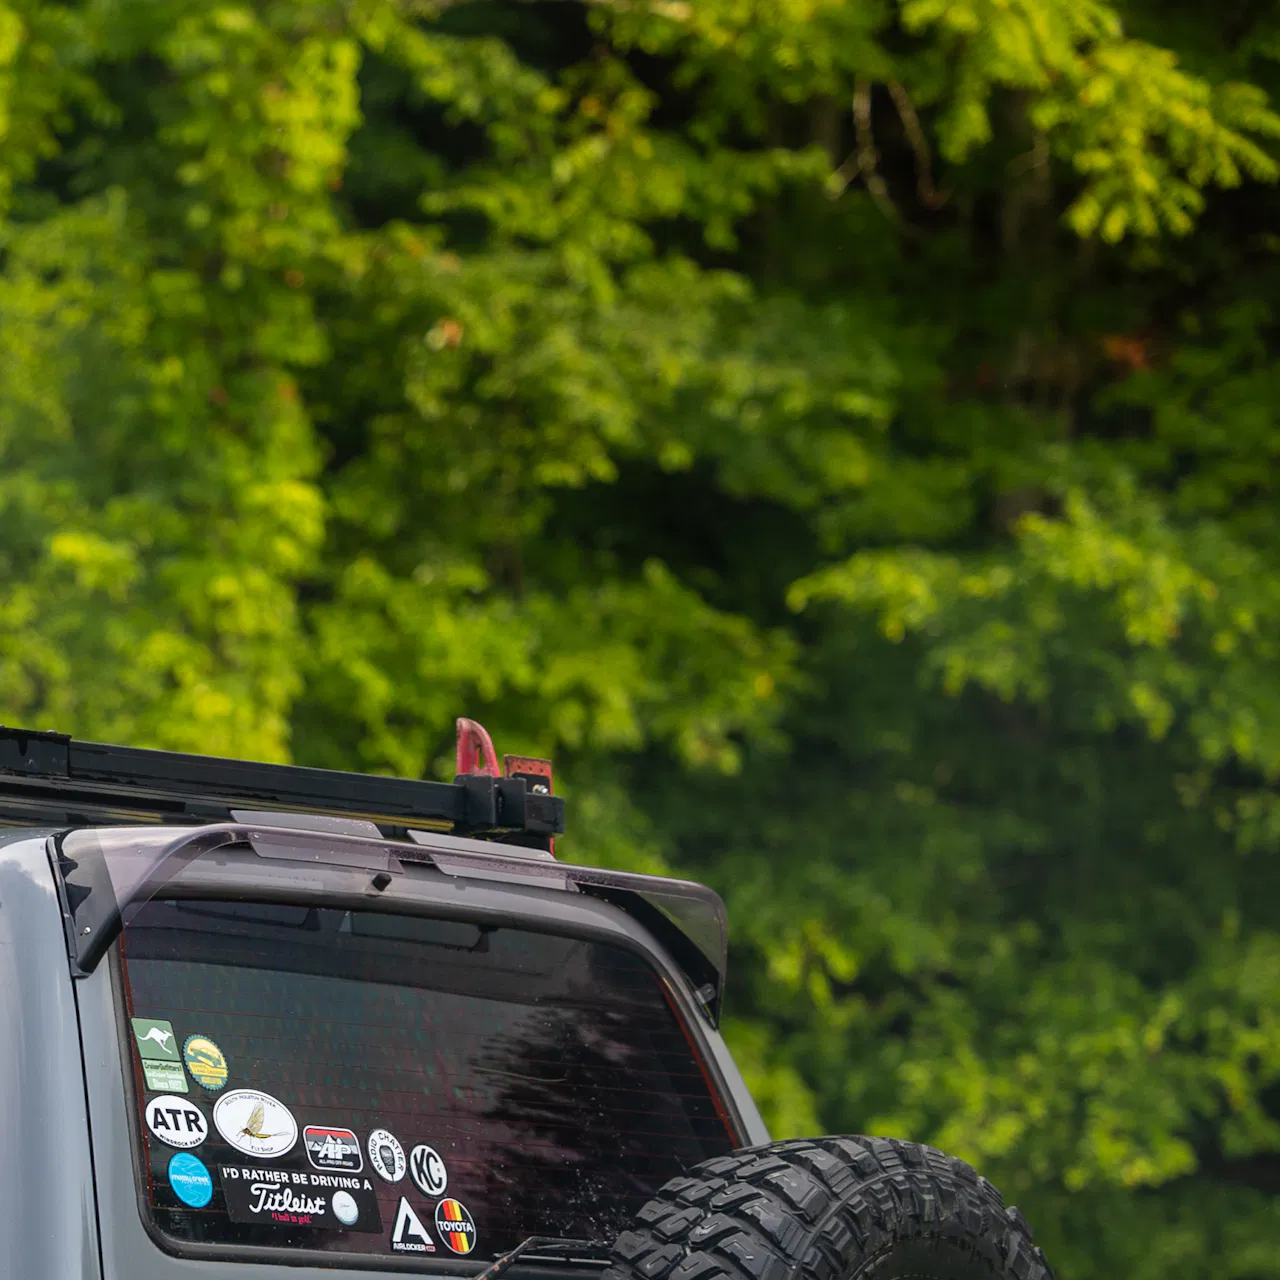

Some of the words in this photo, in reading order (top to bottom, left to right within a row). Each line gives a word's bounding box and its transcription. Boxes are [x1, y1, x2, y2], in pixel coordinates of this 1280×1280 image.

[153, 1107, 204, 1133] ATR
[159, 1133, 189, 1146] WINDROCK
[189, 1137, 202, 1146] PARK
[378, 1132, 403, 1171] CHATTER
[370, 1138, 383, 1171] RADIO
[223, 1167, 239, 1179] I'D
[242, 1168, 289, 1183] RATHER
[292, 1172, 308, 1185] BE
[311, 1174, 360, 1189] DRIVING
[363, 1179, 372, 1190] A
[414, 1148, 443, 1191] KC
[249, 1183, 326, 1214] Titleist
[438, 1221, 473, 1233] TOYOTA
